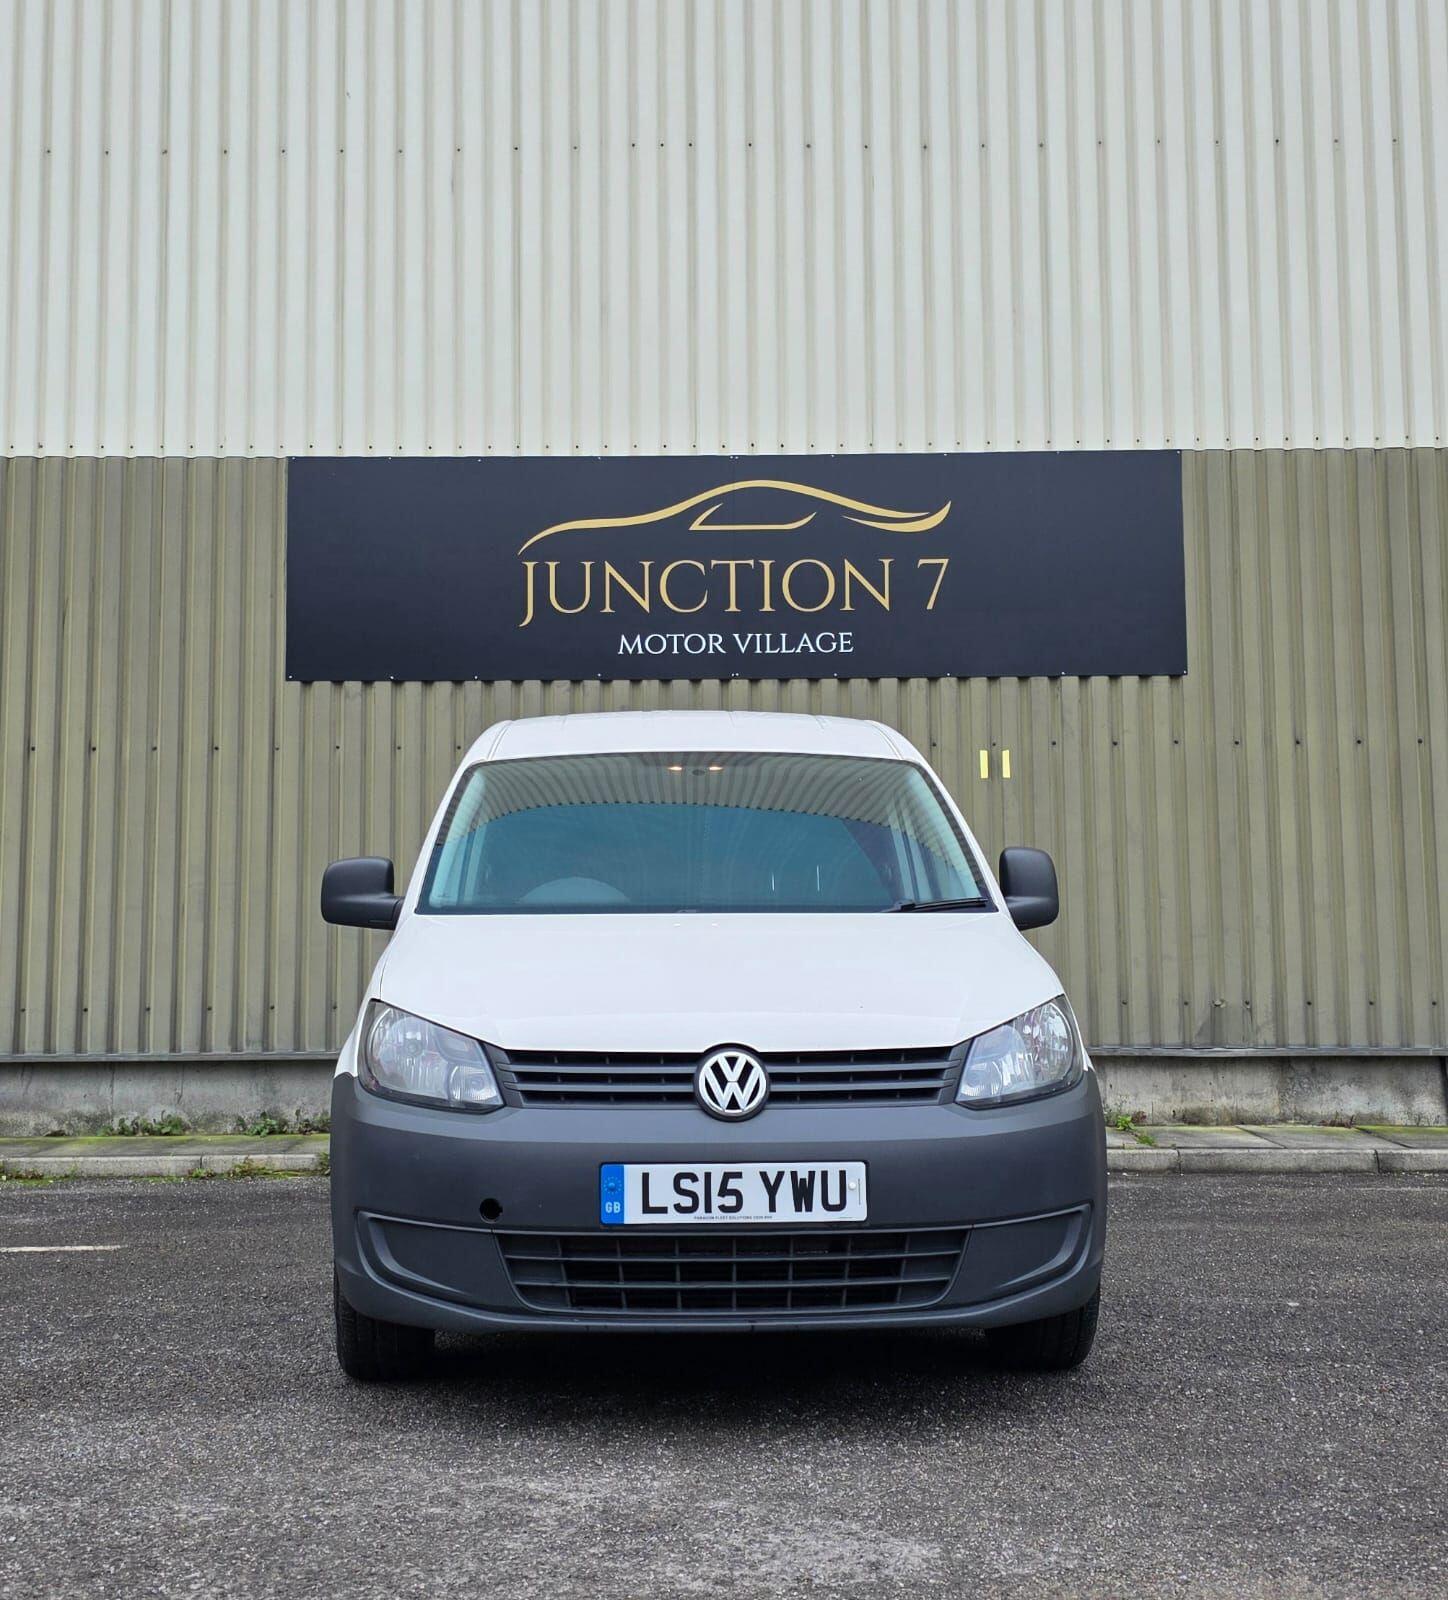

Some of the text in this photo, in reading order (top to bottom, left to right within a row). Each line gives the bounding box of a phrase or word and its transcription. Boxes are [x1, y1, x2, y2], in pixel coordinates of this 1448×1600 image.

[518, 557, 950, 628] JUNCTION 7
[618, 631, 855, 656] MOTOR VILLAGE
[605, 1201, 621, 1214] GB
[641, 1171, 744, 1215] LS15
[759, 1169, 847, 1213] YWU
